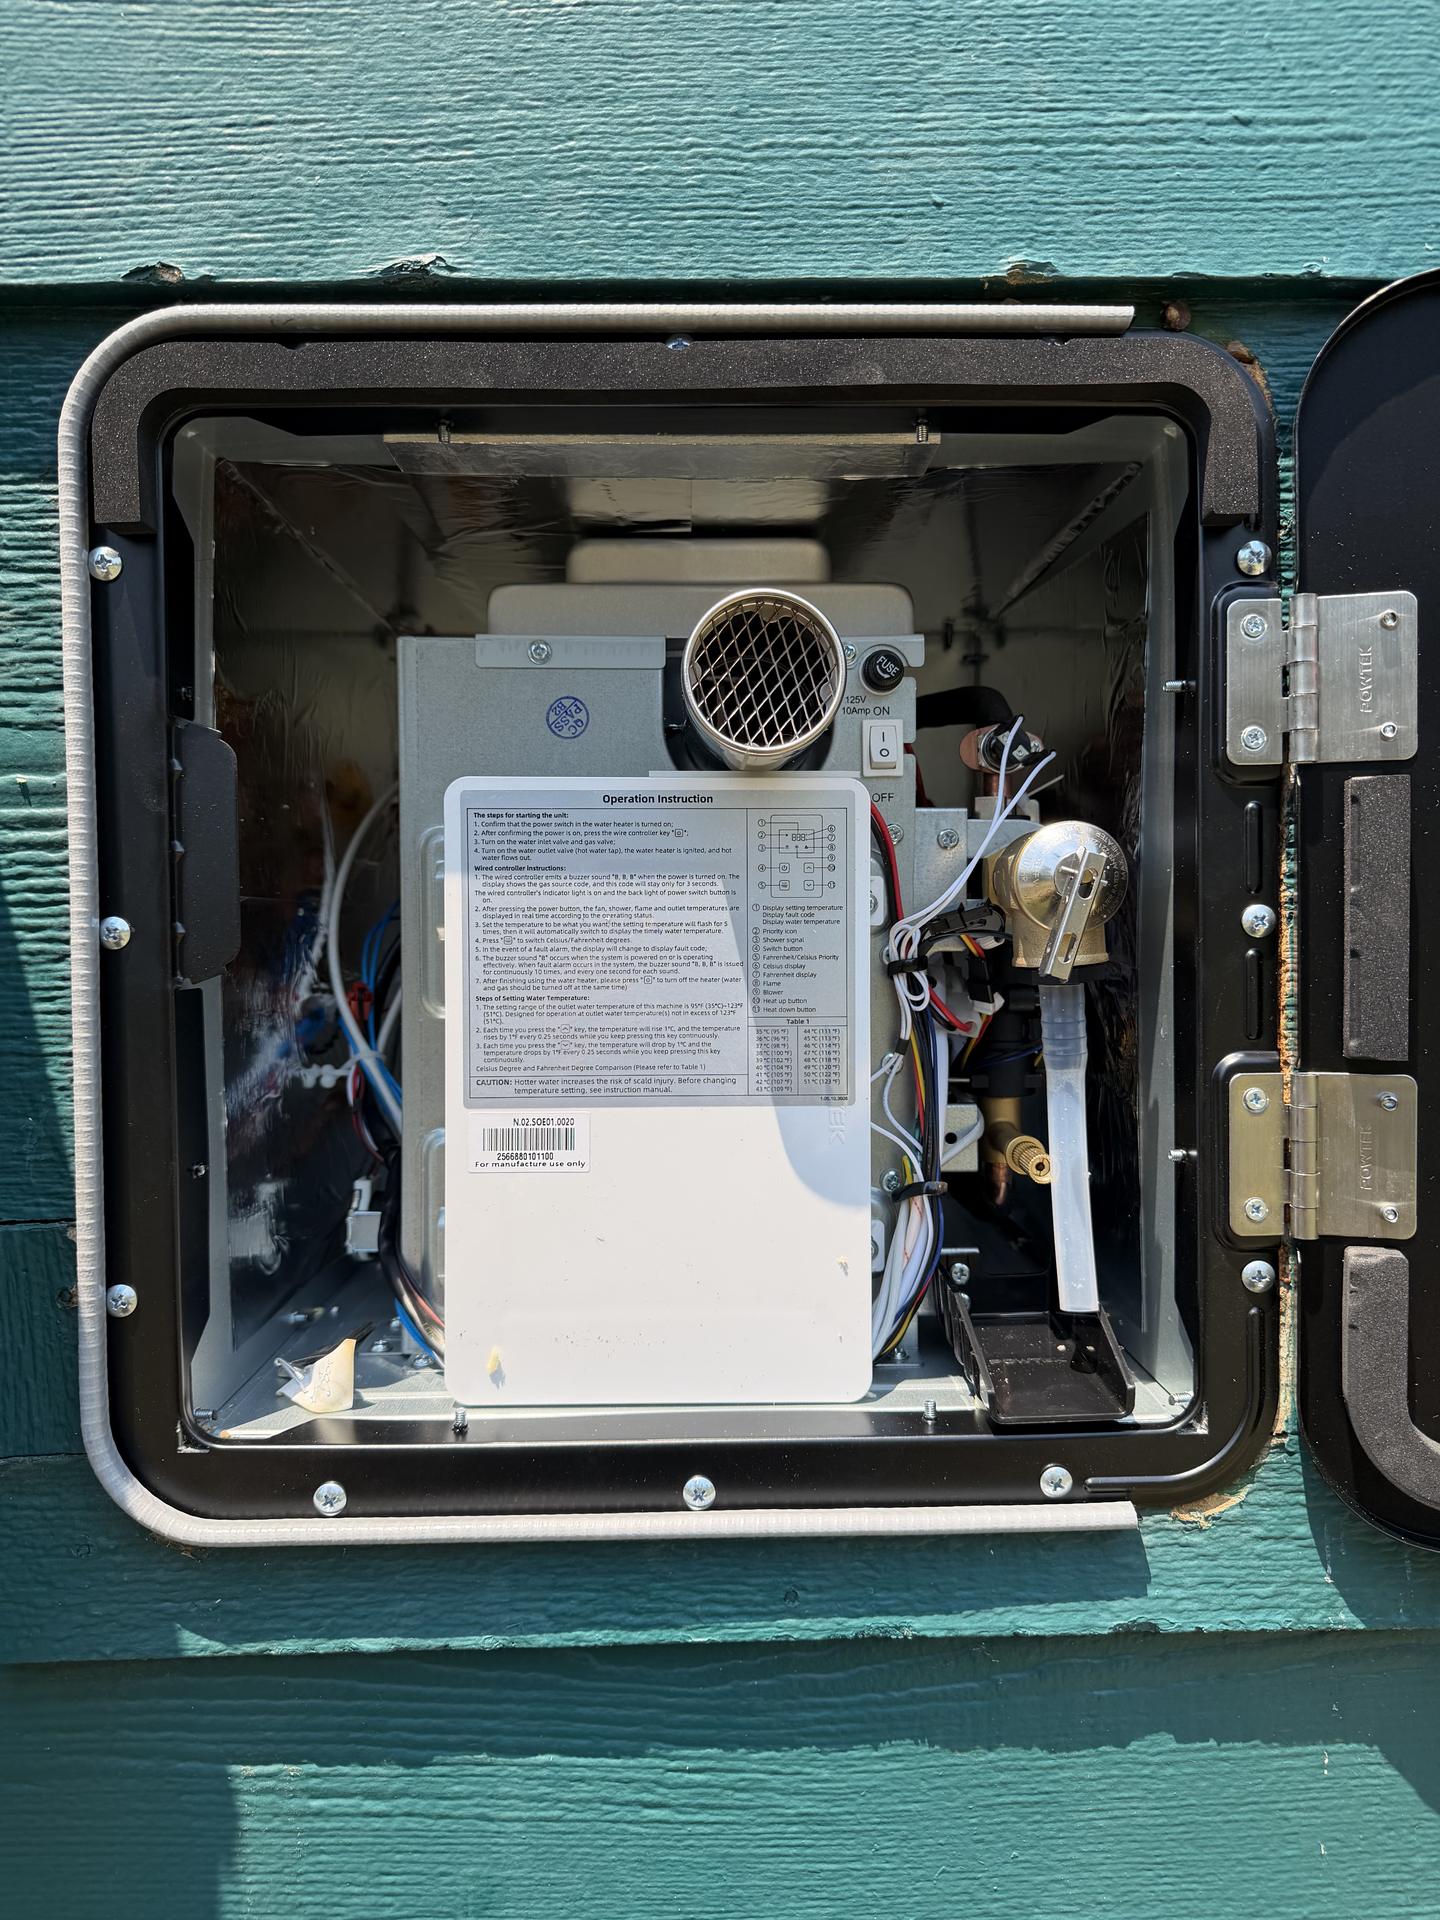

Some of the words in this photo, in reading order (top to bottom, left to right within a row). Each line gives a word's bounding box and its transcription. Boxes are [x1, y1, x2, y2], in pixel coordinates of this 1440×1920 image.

[877, 655, 899, 677] FUSE
[1359, 646, 1373, 714] POWTEK
[842, 707, 870, 716] 10Amp
[873, 707, 890, 715] ON
[554, 704, 582, 732] PASS
[568, 718, 584, 735] QC
[602, 794, 655, 805] Operation
[658, 794, 713, 803] Instruction
[872, 793, 894, 802] OFF
[654, 1077, 676, 1086] injury.
[703, 1077, 736, 1086] changing
[514, 1086, 559, 1095] temperature
[561, 1086, 588, 1095] setting,
